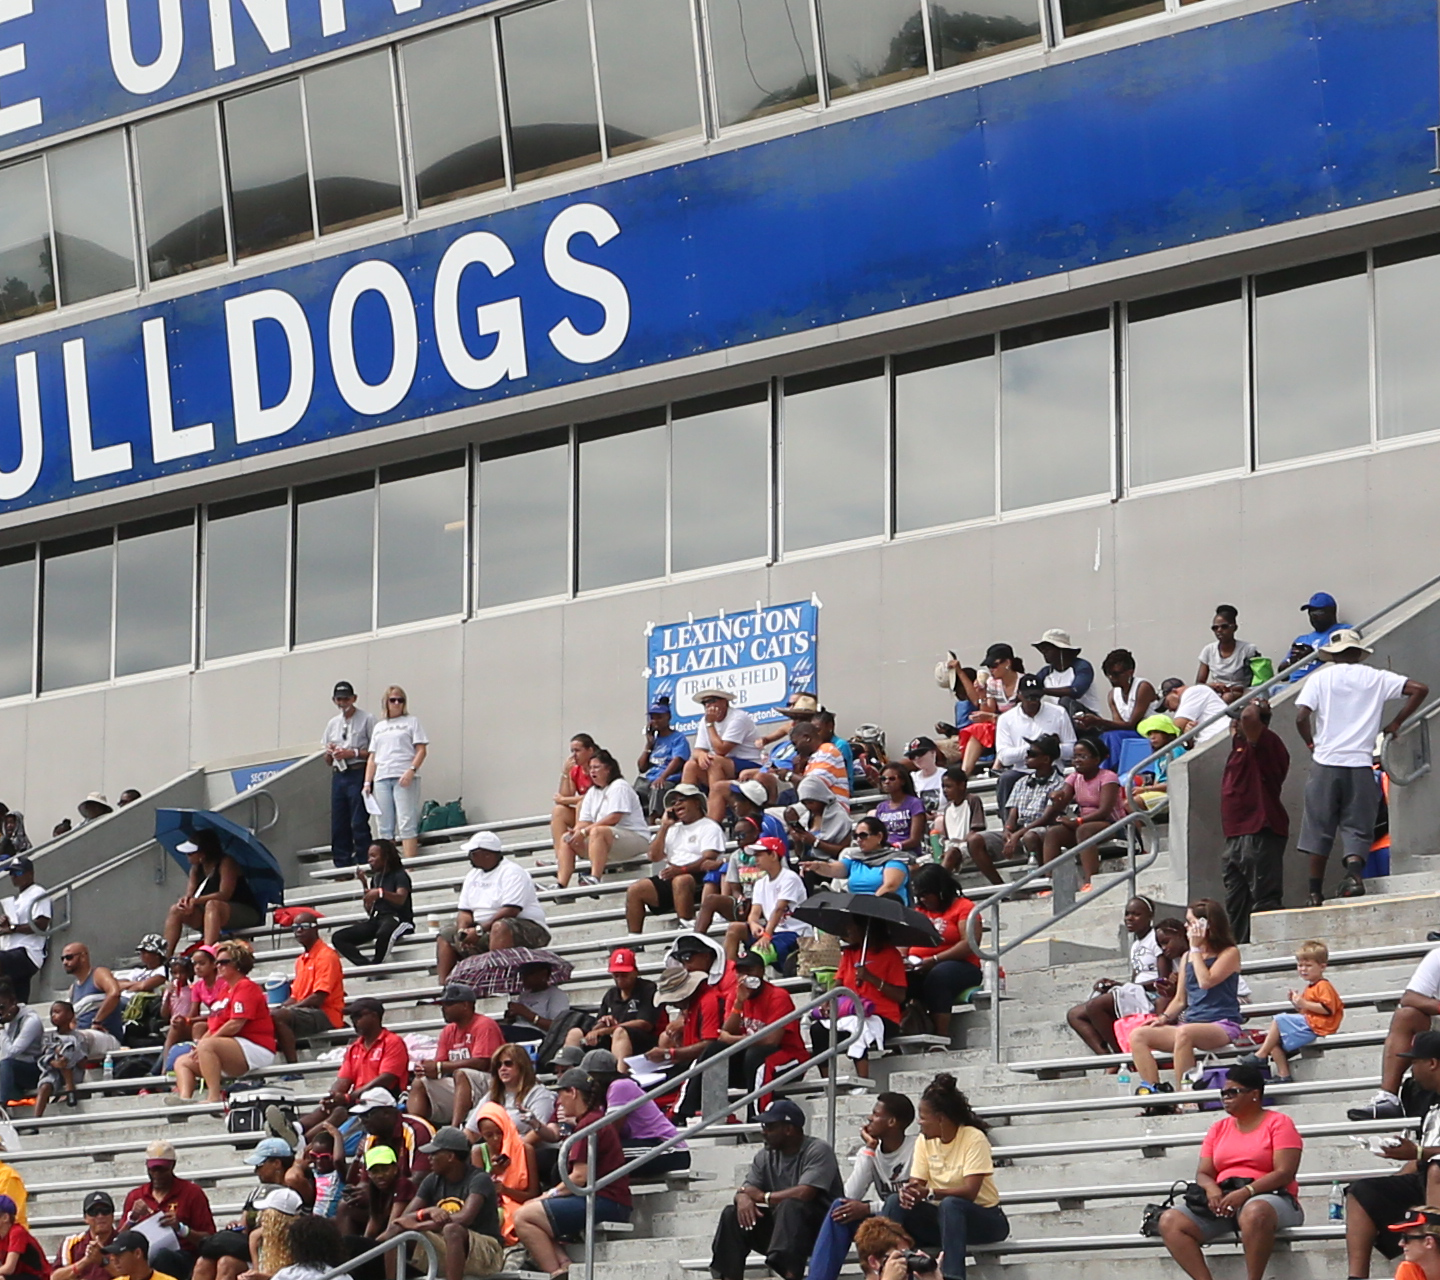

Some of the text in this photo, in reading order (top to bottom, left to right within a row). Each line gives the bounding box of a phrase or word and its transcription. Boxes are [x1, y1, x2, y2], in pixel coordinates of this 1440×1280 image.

[663, 606, 802, 651] LEXINGTON
[654, 631, 809, 678] BLAZIN' CATS
[684, 666, 779, 696] TRACK & FIELD
